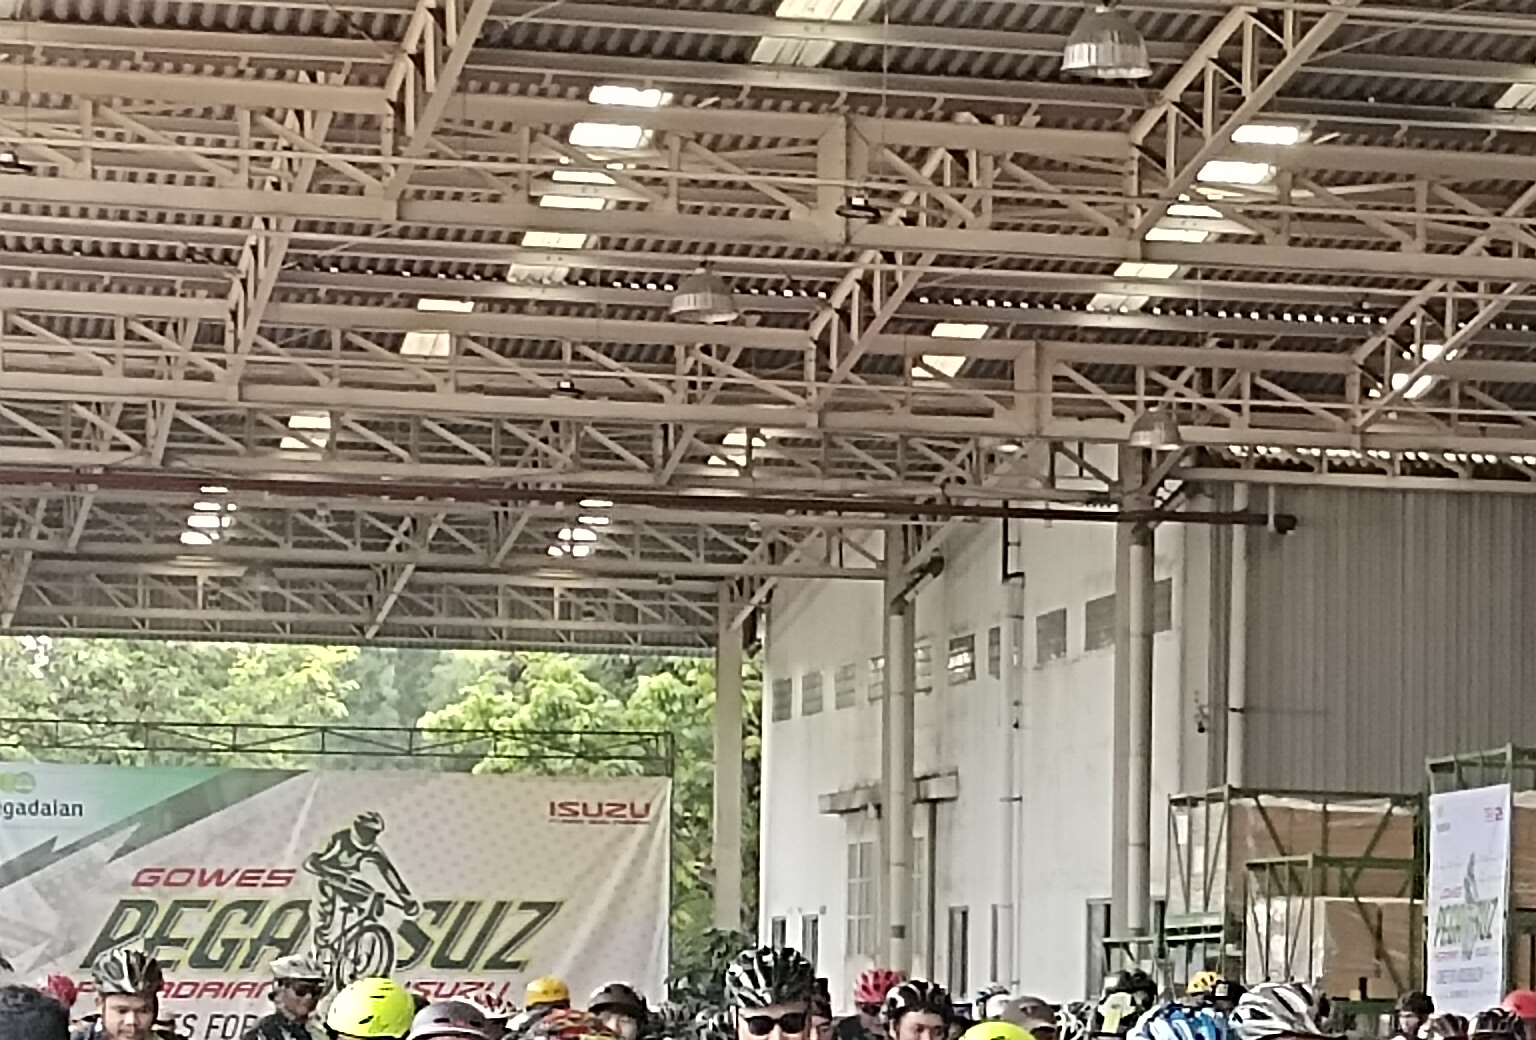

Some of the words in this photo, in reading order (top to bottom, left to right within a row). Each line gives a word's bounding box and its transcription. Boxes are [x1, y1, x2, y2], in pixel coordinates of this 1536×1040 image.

[0, 799, 83, 820] gadaian
[549, 801, 651, 819] ISUZU
[131, 867, 297, 887] GOWES
